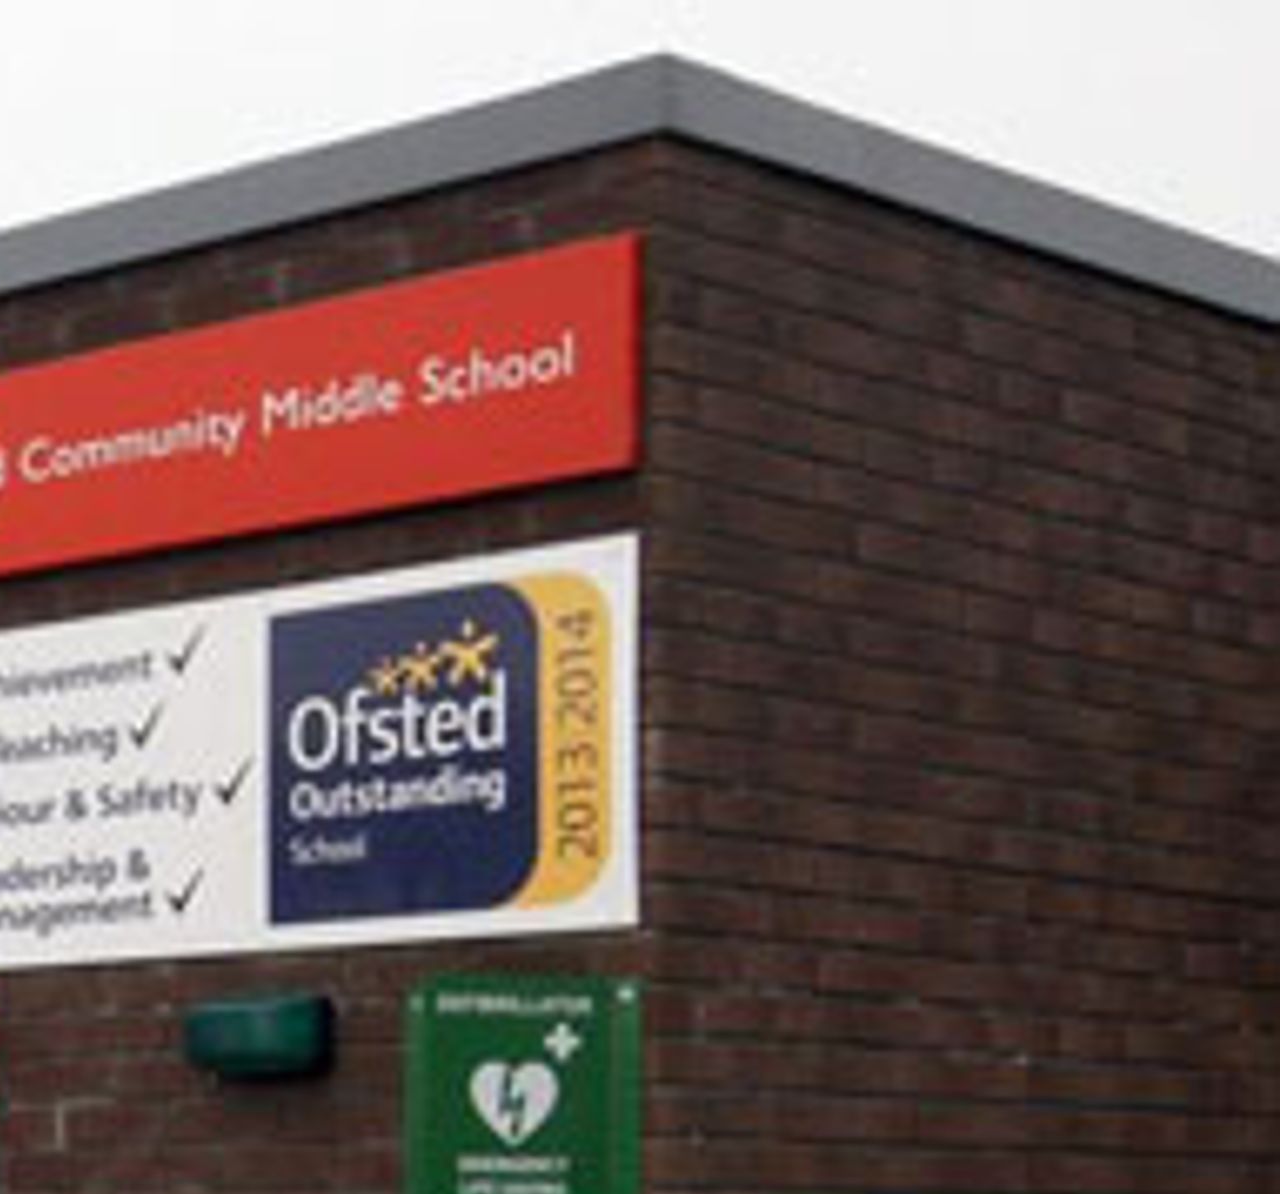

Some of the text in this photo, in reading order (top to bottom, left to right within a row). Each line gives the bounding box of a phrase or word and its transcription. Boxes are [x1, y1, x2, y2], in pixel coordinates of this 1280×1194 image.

[19, 410, 245, 482] Community
[262, 375, 404, 437] Middle
[418, 330, 576, 407] School
[289, 668, 508, 772] Ofsted
[555, 607, 599, 860] 2013 2014
[65, 789, 89, 821] &
[96, 779, 204, 827] Safety
[289, 765, 508, 820] Outstanding
[127, 849, 151, 881] &
[289, 832, 367, 868] School
